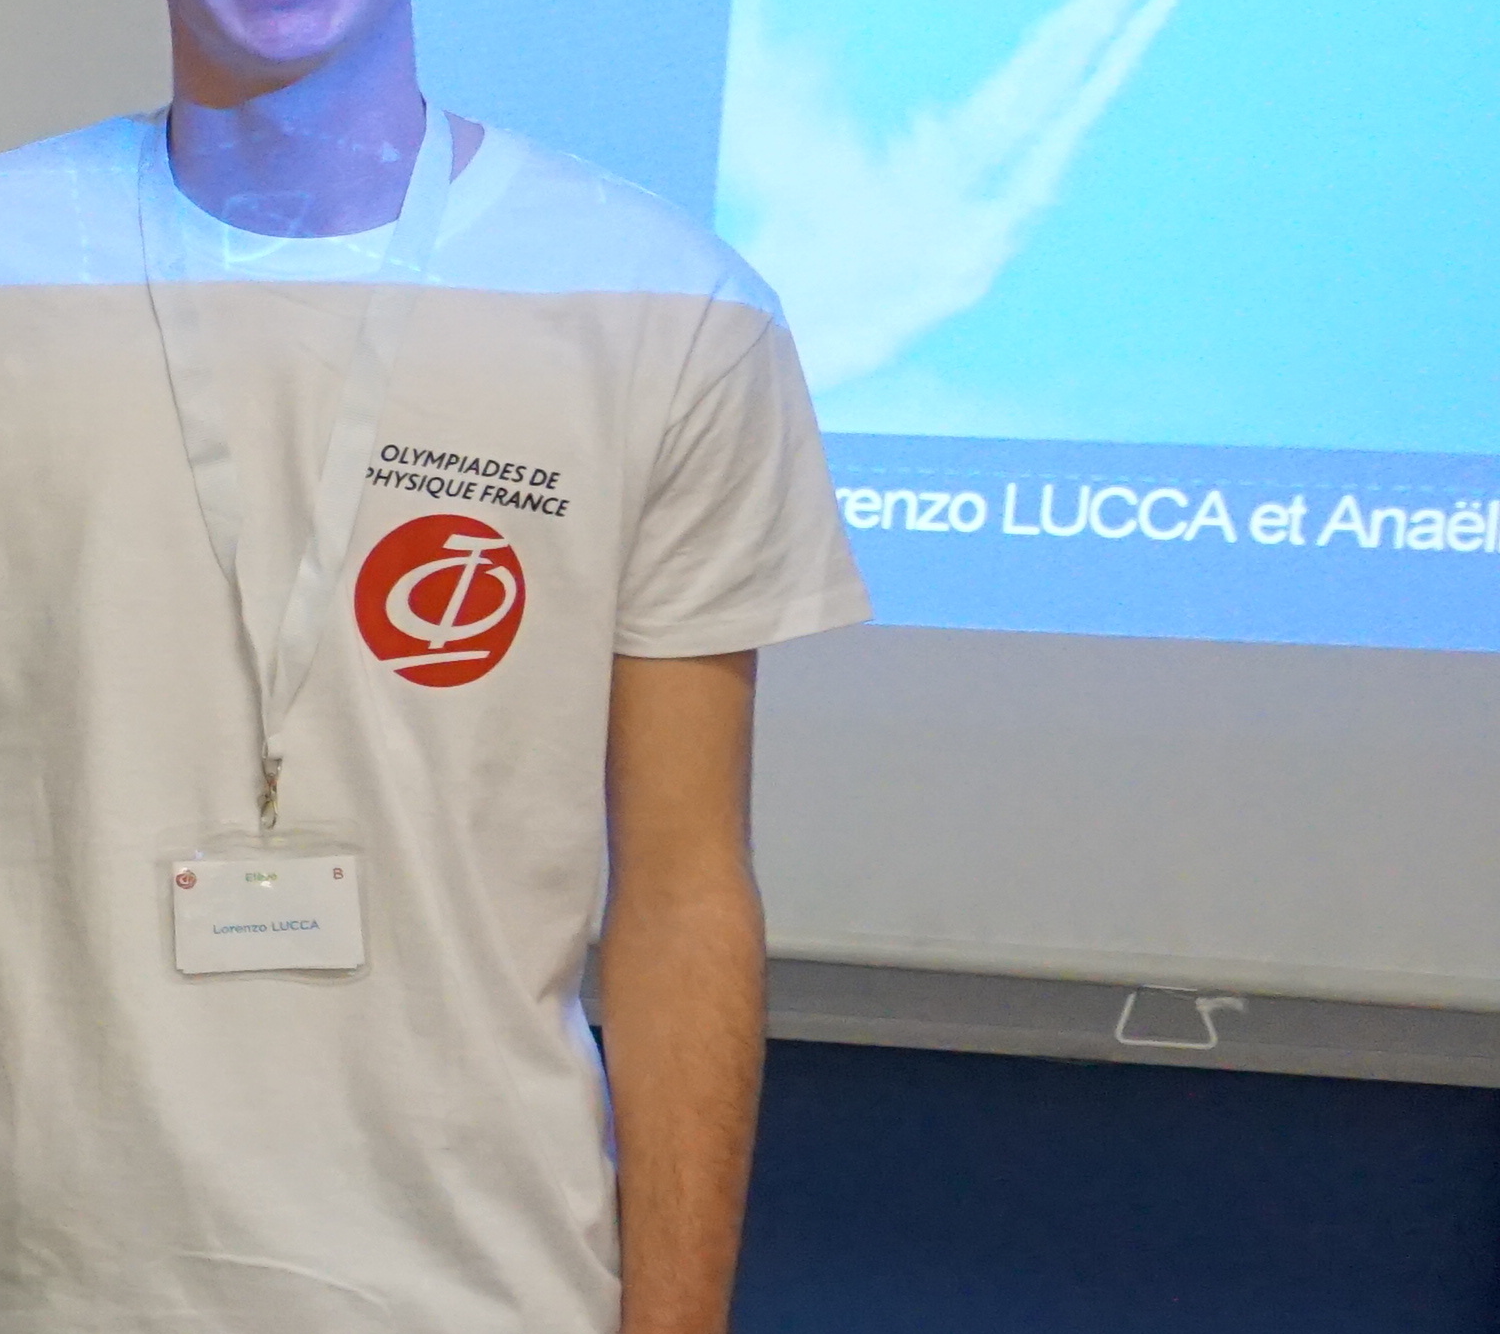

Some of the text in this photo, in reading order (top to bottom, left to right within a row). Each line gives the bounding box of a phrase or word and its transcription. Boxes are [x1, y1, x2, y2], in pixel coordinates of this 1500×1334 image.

[380, 444, 561, 490] OLYMPIADES DE
[479, 485, 571, 517] FRANCE
[1004, 483, 1239, 545] LUCCA
[1250, 495, 1307, 547] et
[1314, 494, 1500, 553] Anaël
[332, 867, 345, 881] B
[212, 919, 321, 935] Lorenzo LUCCA
